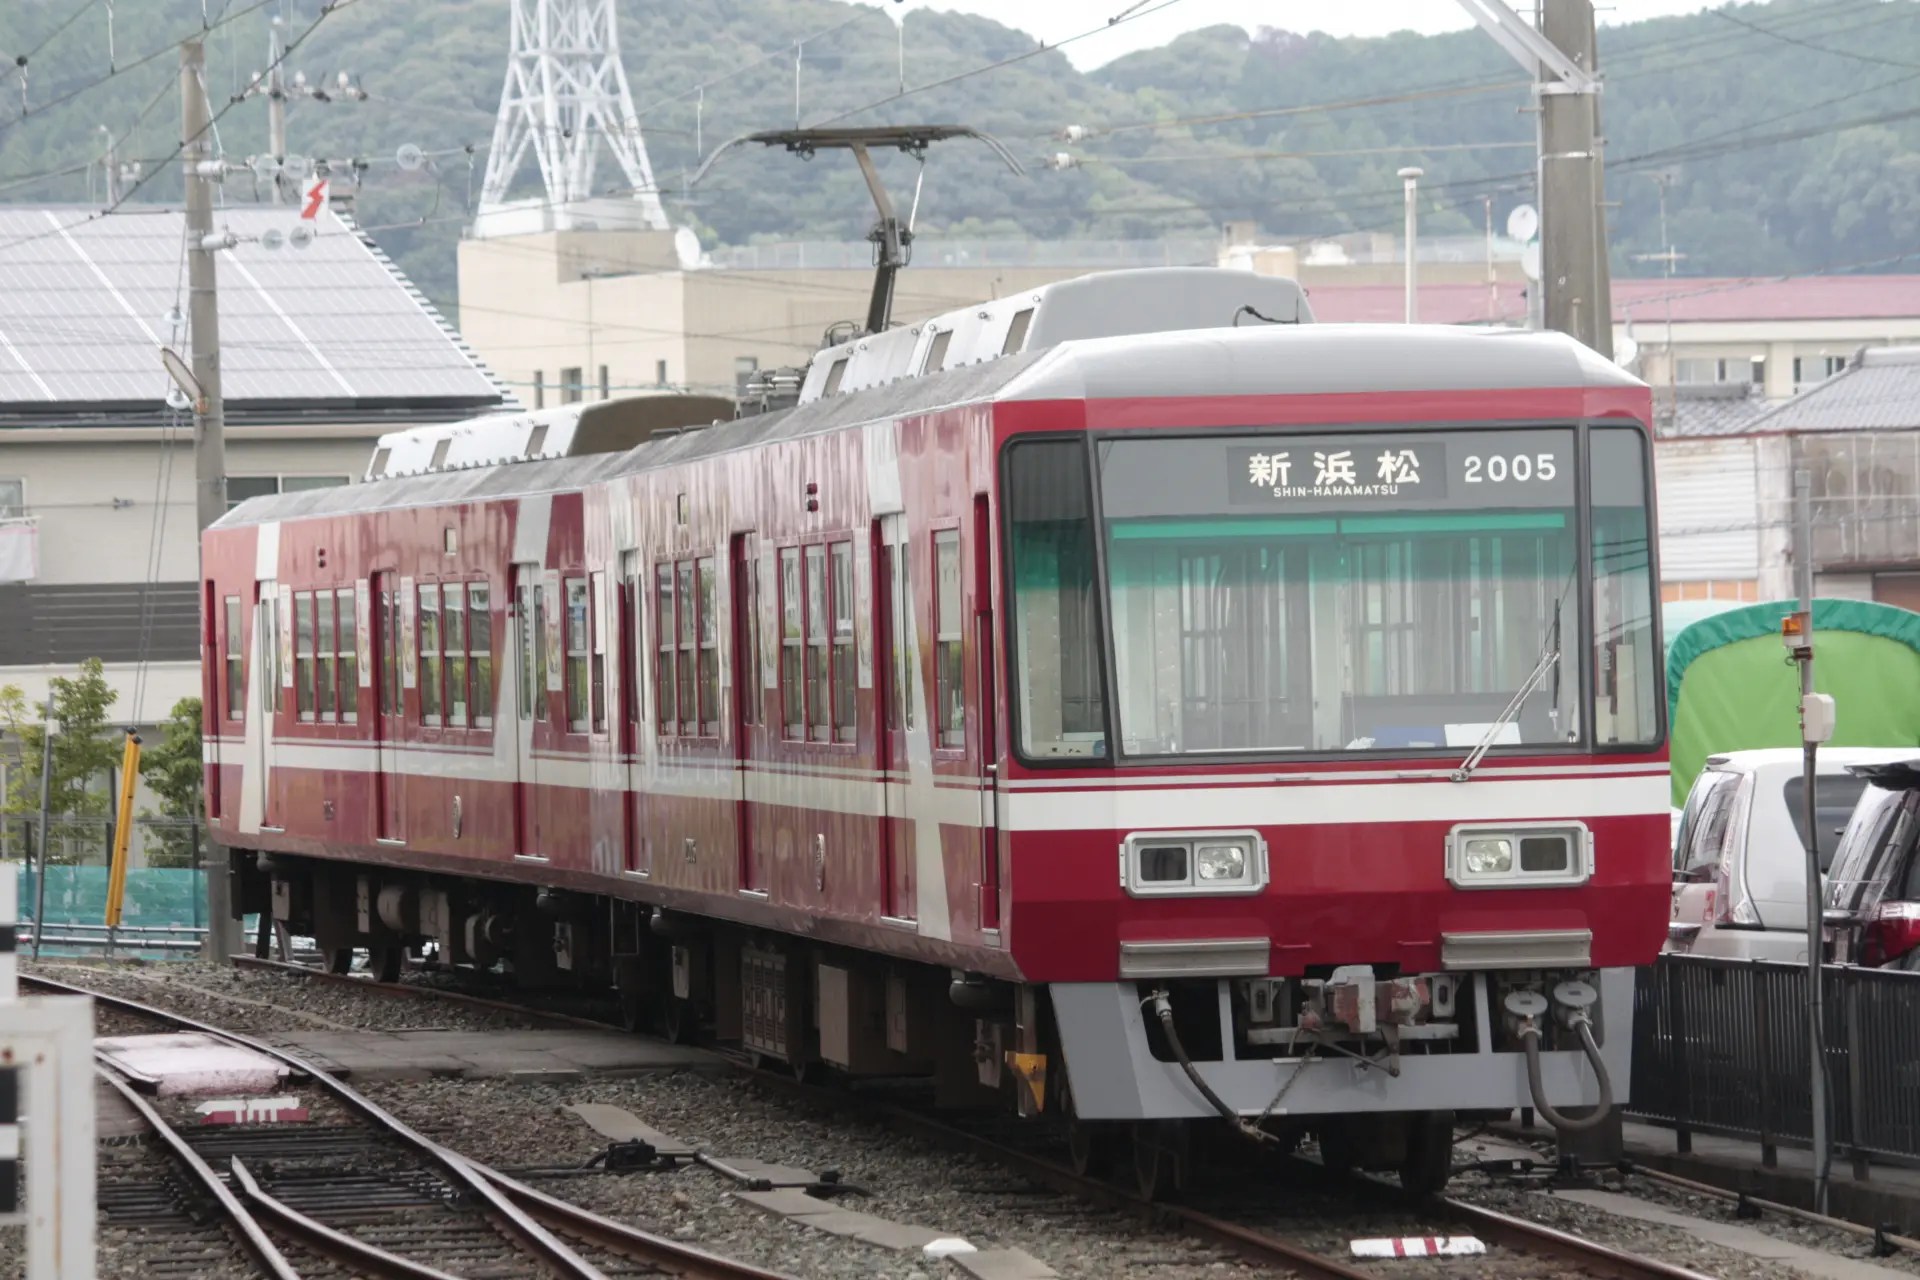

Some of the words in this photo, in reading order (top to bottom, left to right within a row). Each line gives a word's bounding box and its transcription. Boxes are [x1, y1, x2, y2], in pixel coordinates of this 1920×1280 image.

[1248, 450, 1421, 487] 新浜松
[1464, 453, 1557, 483] 2005
[1273, 484, 1399, 498] SHIN-HAMAMATSU
